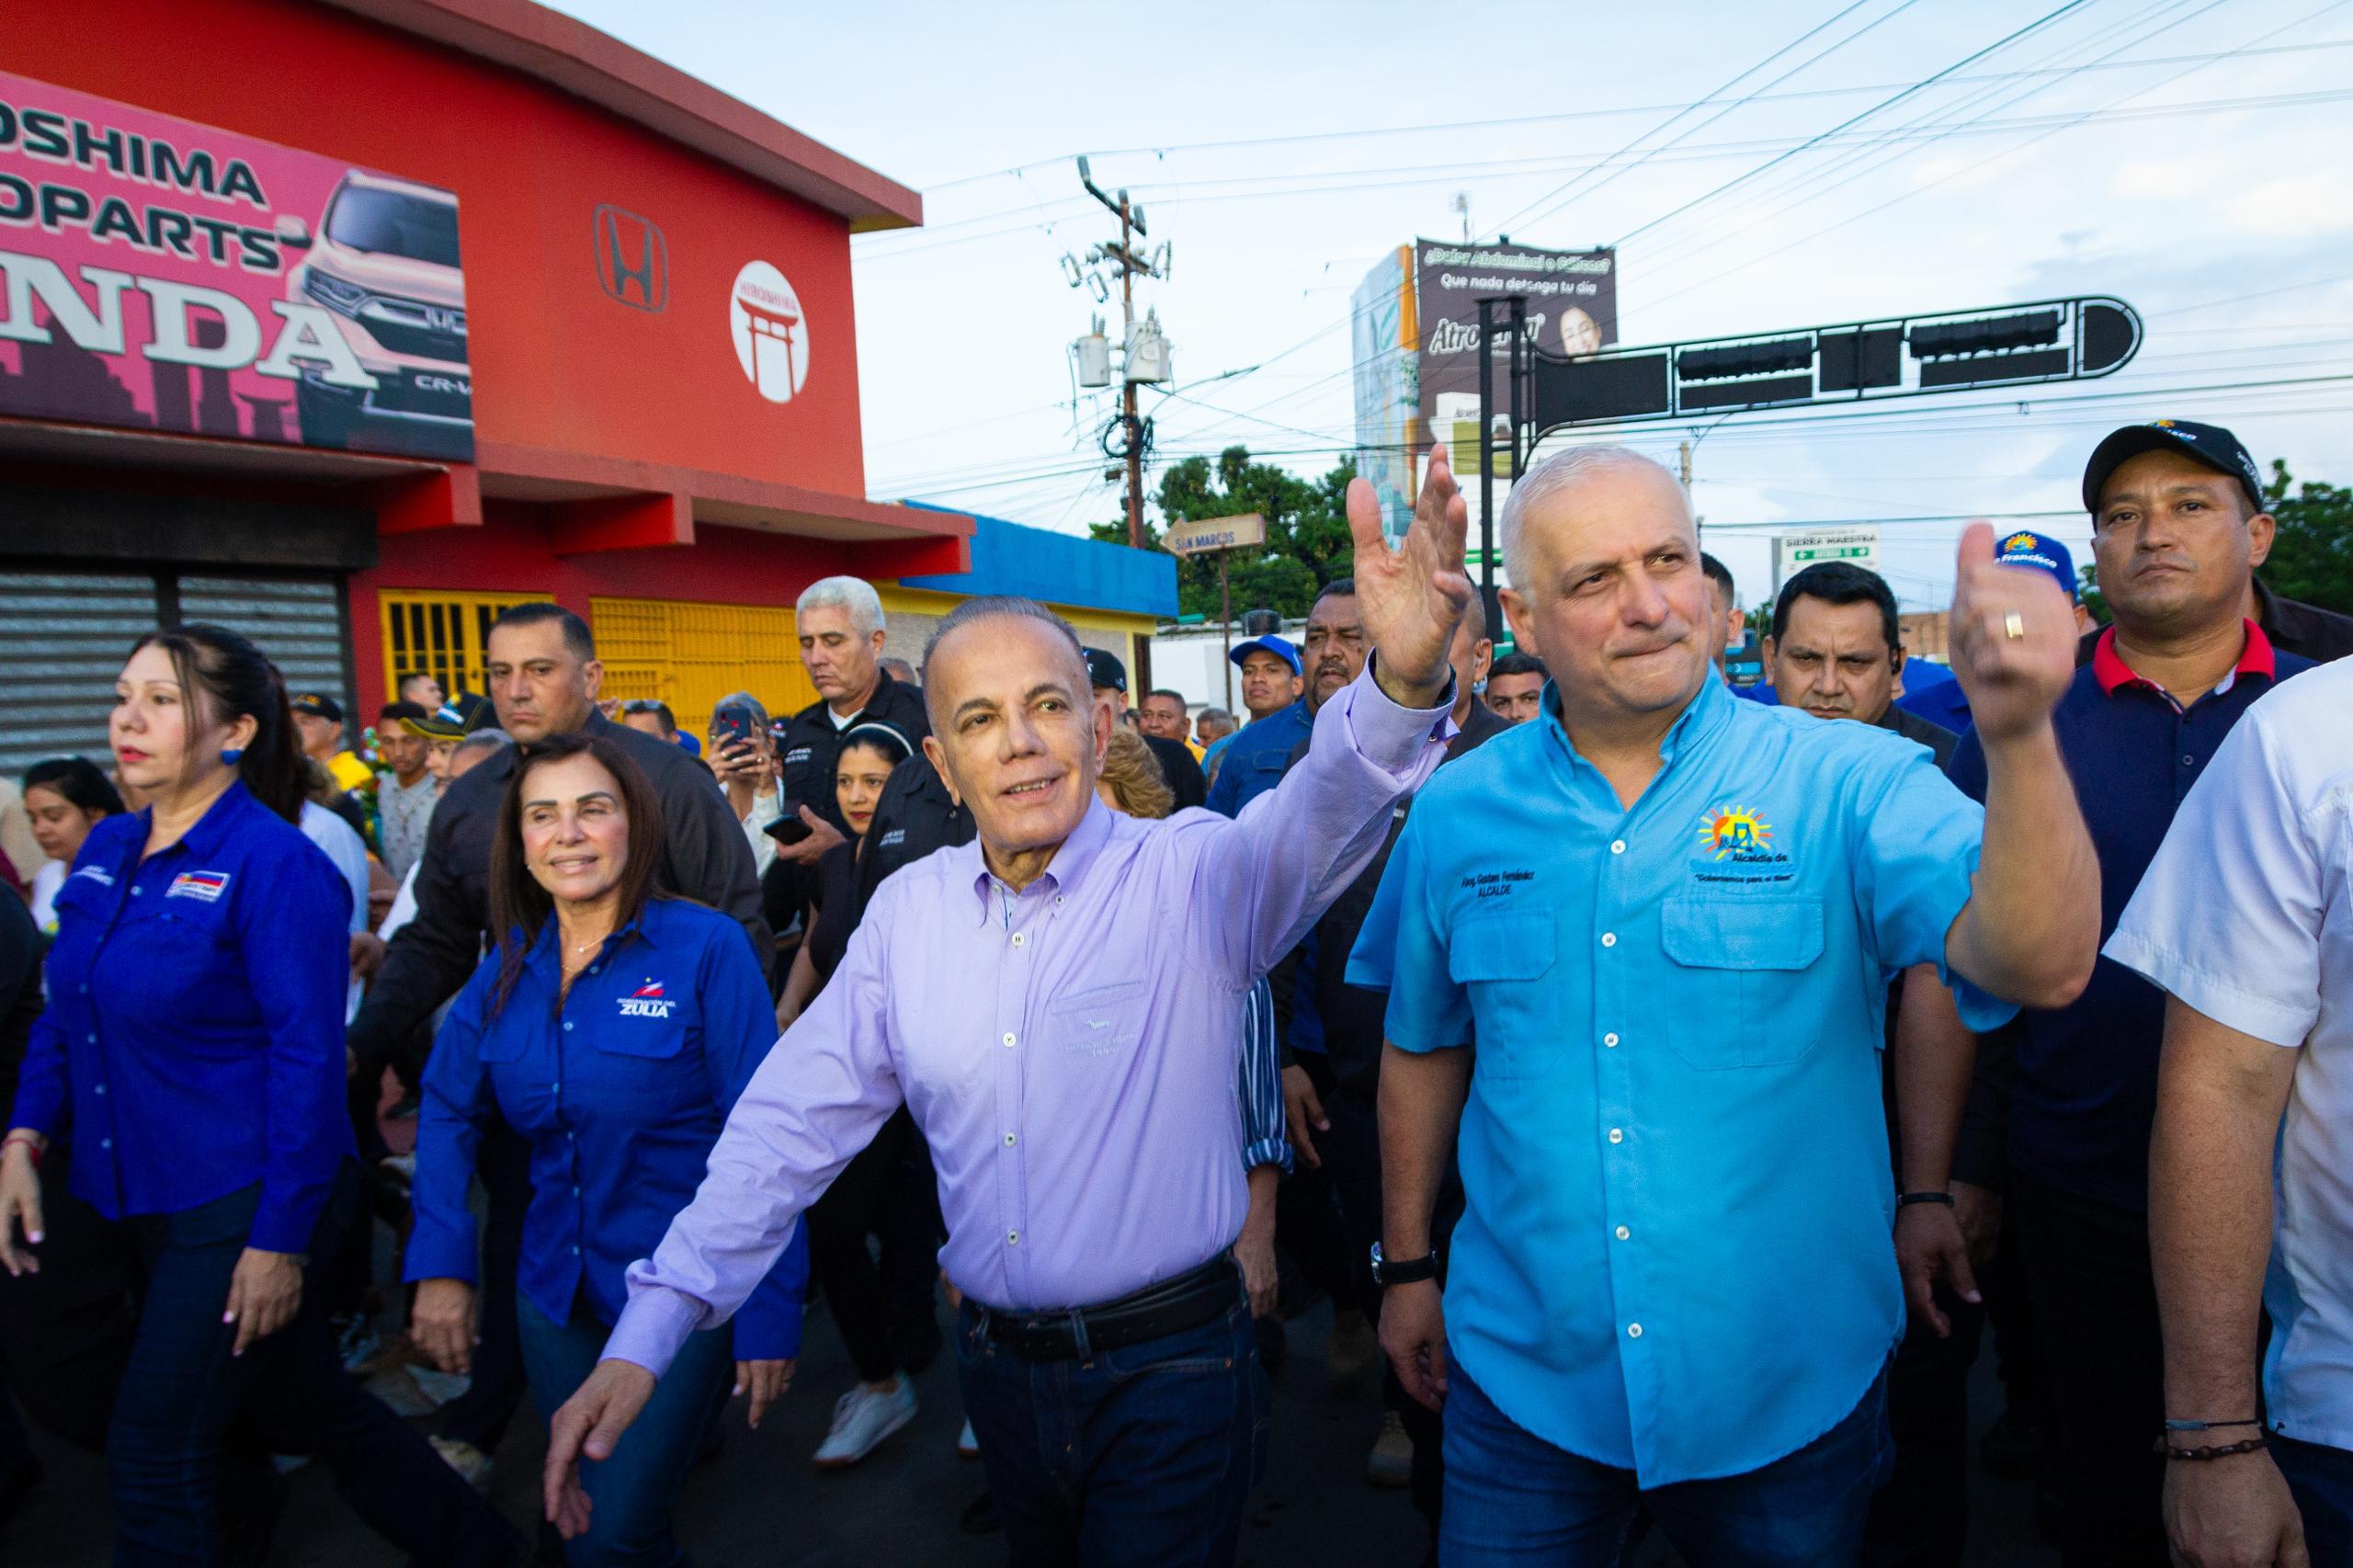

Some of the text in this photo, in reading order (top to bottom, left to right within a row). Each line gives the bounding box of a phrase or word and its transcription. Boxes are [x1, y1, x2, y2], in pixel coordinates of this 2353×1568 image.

[0, 174, 280, 273] OPARTS
[1440, 273, 1597, 296] Que nada detenga tu día
[0, 250, 379, 390] NDA
[1787, 537, 1822, 547] SIERRA
[2001, 553, 2057, 568] Francisco
[1477, 884, 1512, 897] ALCALDE
[619, 1004, 668, 1018] ZULIA
